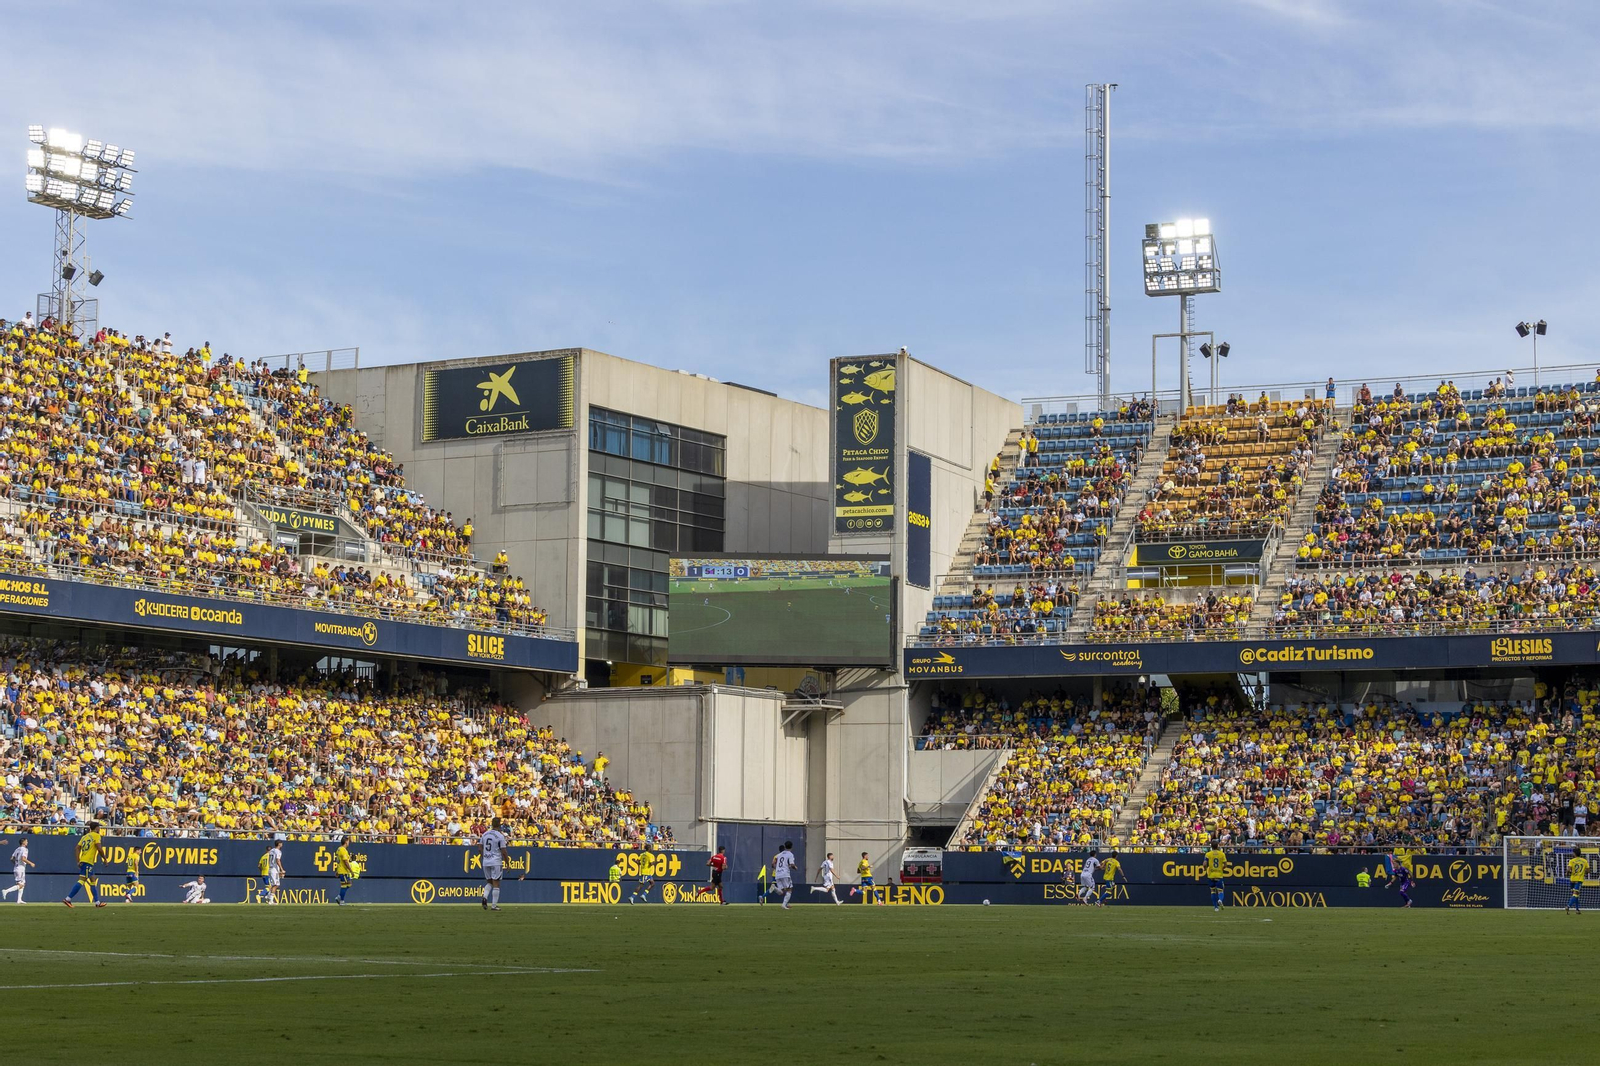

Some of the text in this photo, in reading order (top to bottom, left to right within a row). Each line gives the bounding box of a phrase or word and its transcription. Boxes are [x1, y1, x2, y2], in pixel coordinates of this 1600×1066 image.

[465, 414, 530, 434] CaixaBank
[868, 447, 889, 455] CHICO
[842, 507, 888, 516] petacachico.com
[302, 516, 335, 531] PYMES
[1188, 547, 1239, 559] GAMO BAHÍA
[32, 582, 50, 595] S.L.
[200, 608, 243, 625] coanda
[314, 622, 363, 638] MOVITRANSA
[467, 633, 505, 655] SLICE
[908, 665, 963, 674] MOVANBUS
[1112, 658, 1143, 670] academy
[81, 839, 92, 852] 23
[485, 838, 493, 852] 5
[165, 847, 218, 865] PYMES
[778, 856, 785, 868] 8
[1213, 857, 1219, 868] 8
[1085, 860, 1092, 869] 9
[1222, 860, 1279, 878] Solera
[1477, 864, 1544, 880] PYMES
[438, 887, 463, 897] GAMO
[560, 881, 622, 904] TELENO
[1441, 887, 1490, 902] La Marea
